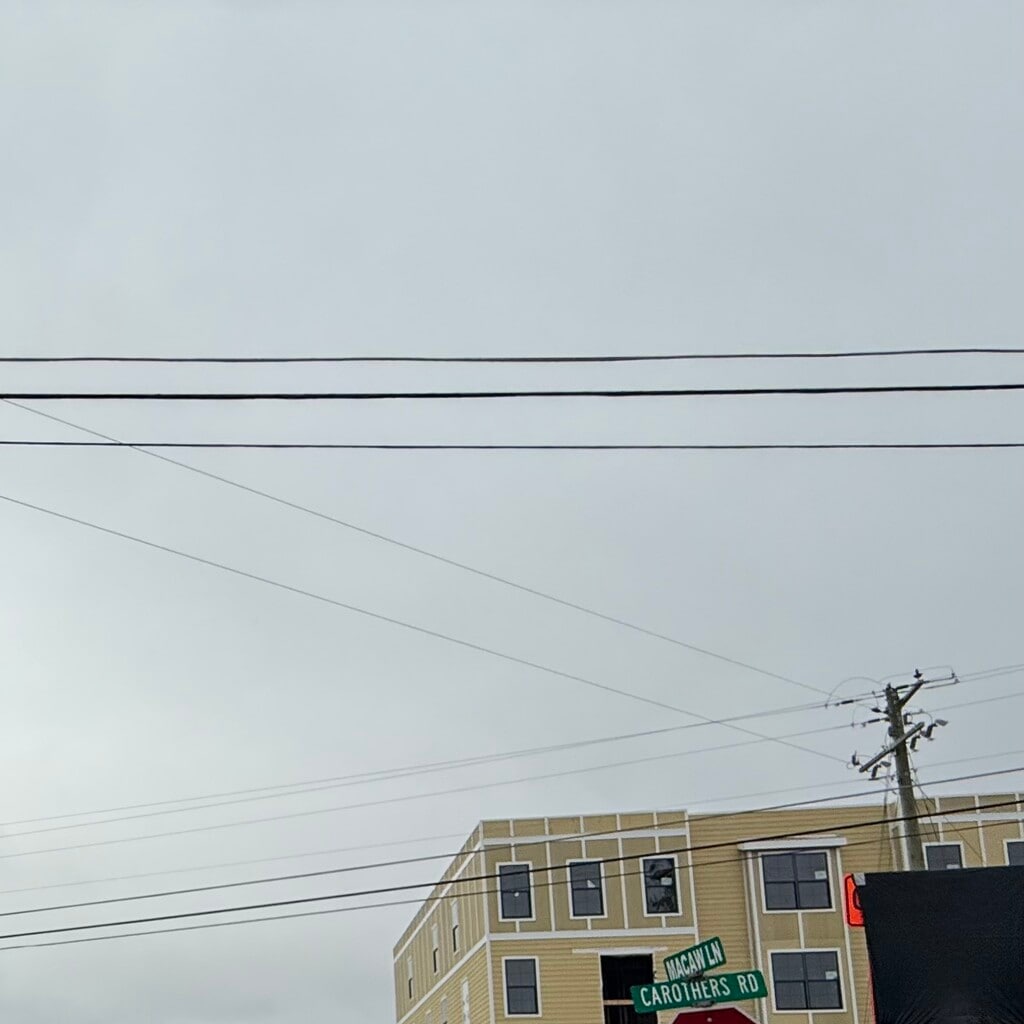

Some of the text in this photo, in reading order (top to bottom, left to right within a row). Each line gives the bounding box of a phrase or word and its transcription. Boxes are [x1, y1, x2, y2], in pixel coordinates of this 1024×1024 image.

[665, 940, 724, 981] MACAW LN
[640, 973, 759, 1007] CAROTHERS RD
